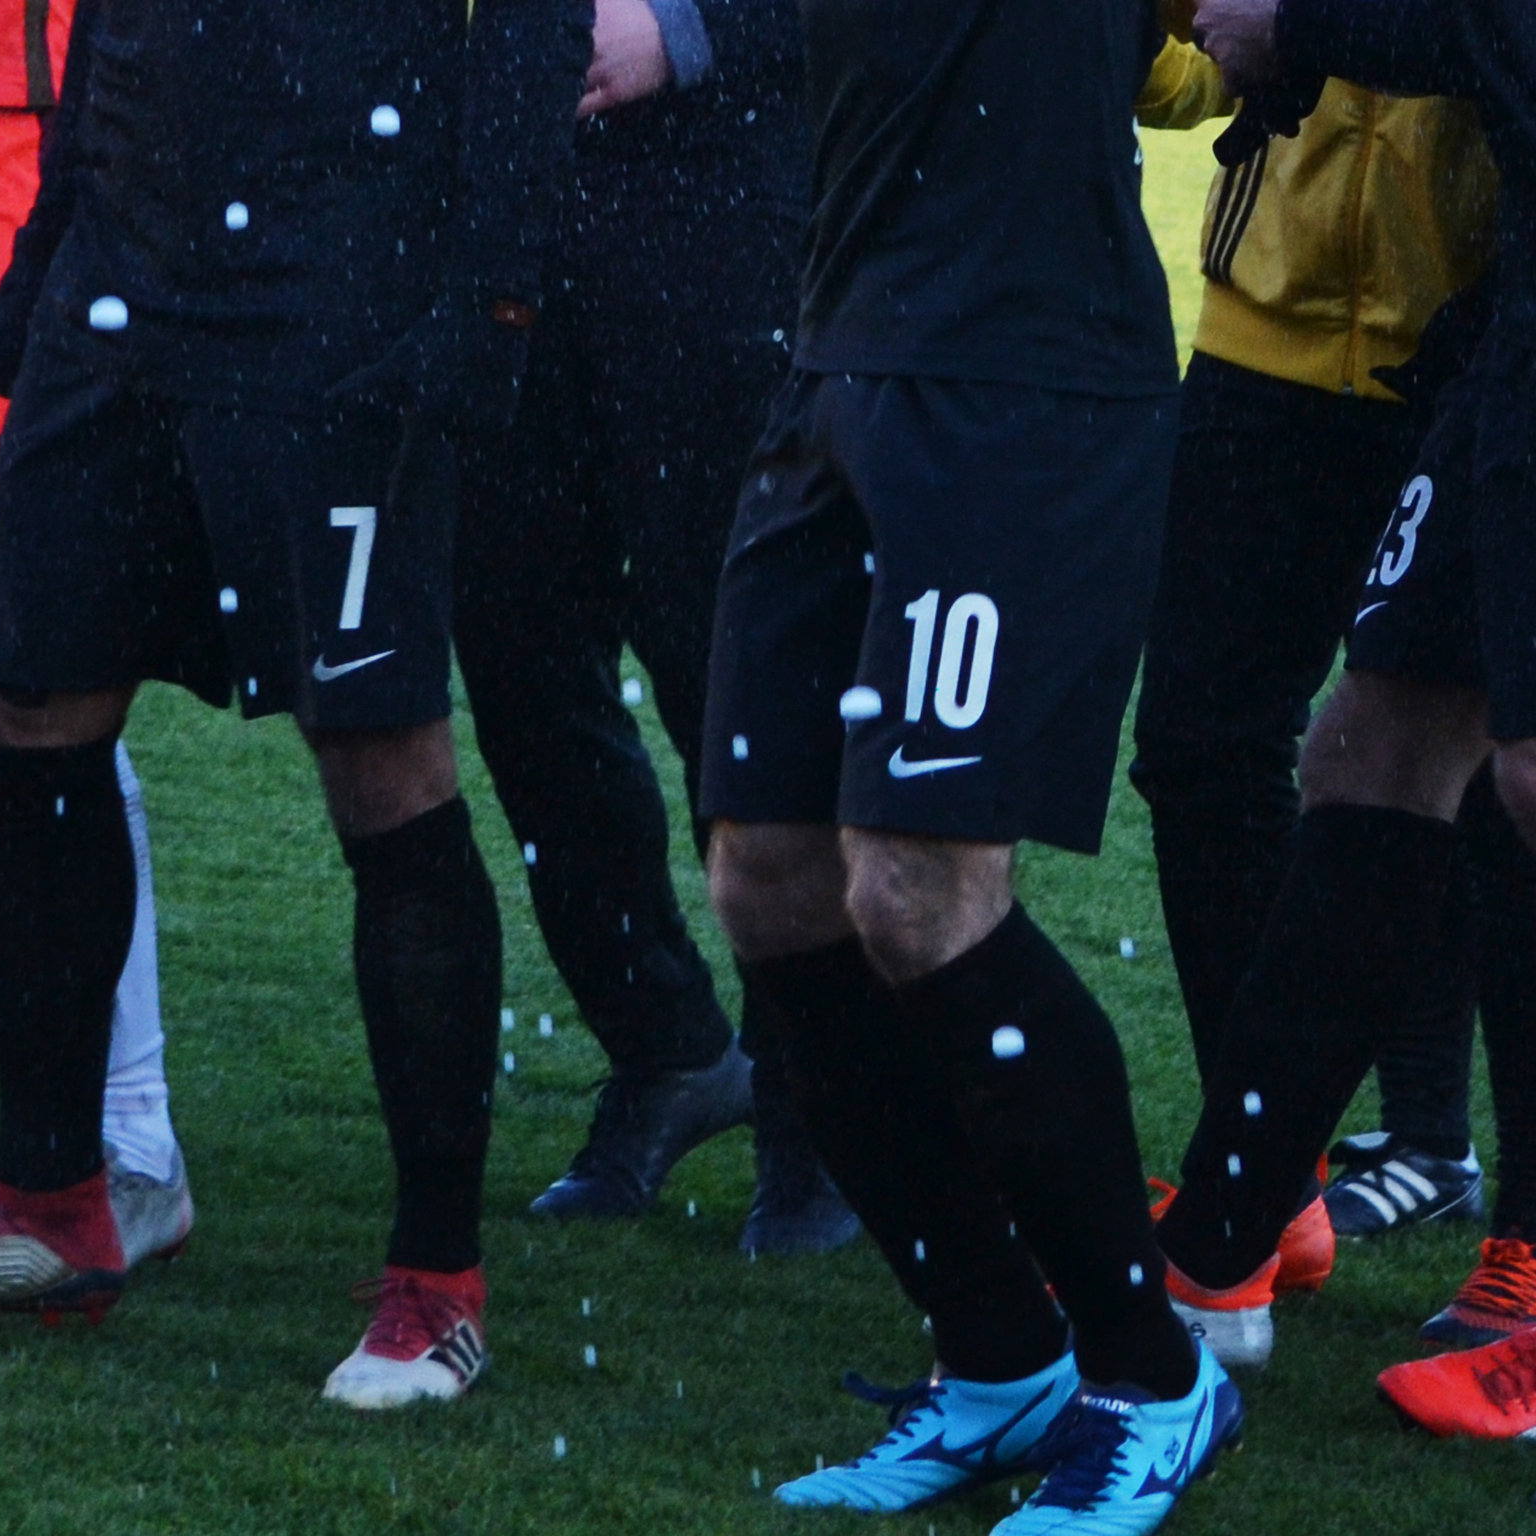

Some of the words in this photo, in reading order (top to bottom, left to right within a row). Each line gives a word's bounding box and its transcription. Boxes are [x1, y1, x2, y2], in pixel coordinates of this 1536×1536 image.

[330, 506, 377, 629] 7
[1362, 473, 1435, 586] 3
[905, 589, 999, 729] 10
